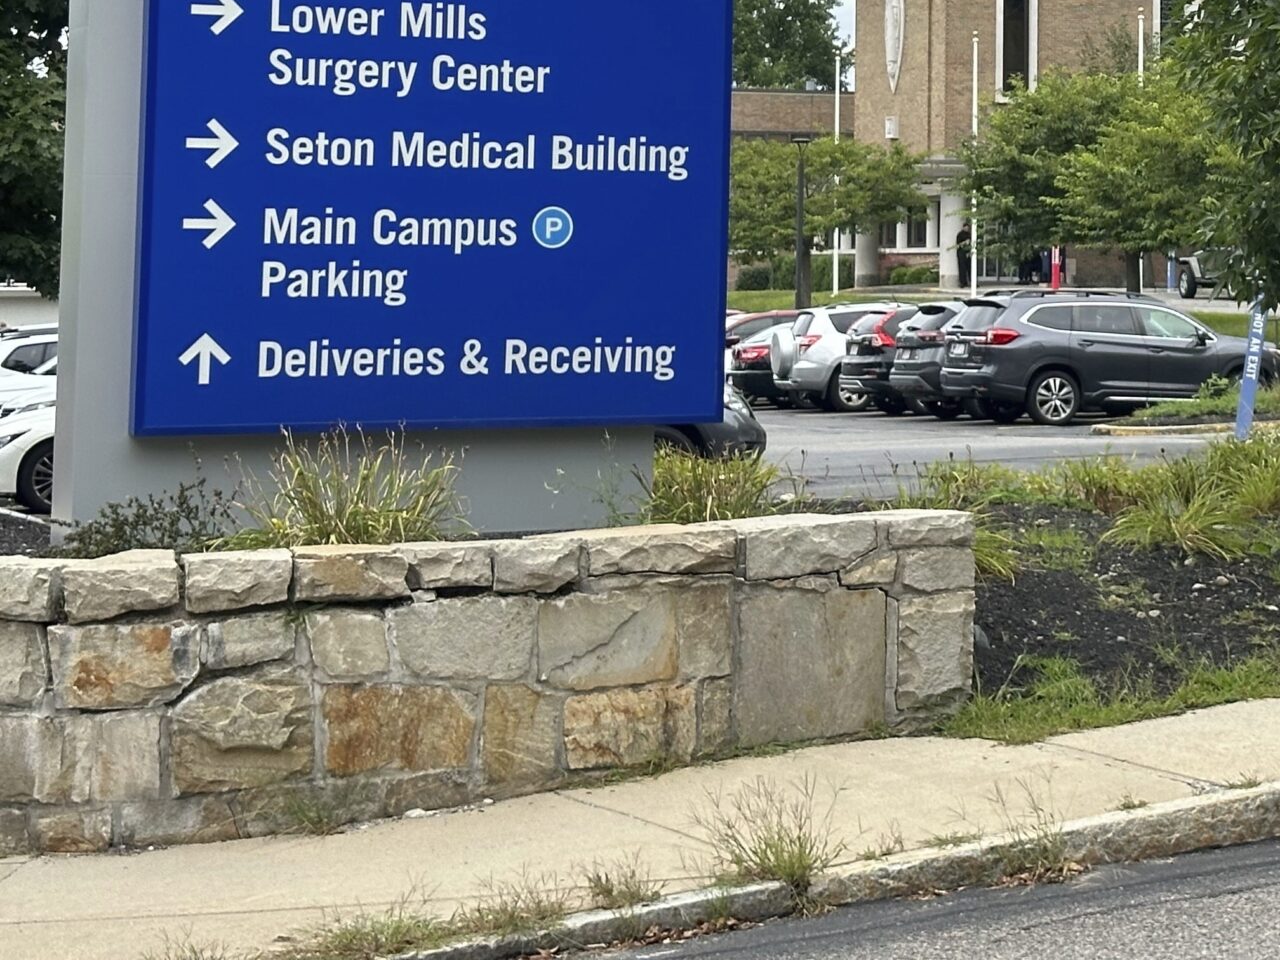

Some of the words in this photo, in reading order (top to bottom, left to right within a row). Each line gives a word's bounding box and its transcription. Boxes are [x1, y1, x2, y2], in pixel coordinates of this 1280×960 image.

[400, 1, 487, 41] Mills
[268, 48, 418, 98] Surgery
[431, 54, 551, 93] Center
[265, 127, 375, 167] Seton
[391, 131, 536, 170] Medical
[551, 134, 690, 181] Building
[263, 207, 357, 246] Main
[373, 208, 518, 255] Campus
[546, 217, 563, 239] P
[261, 259, 408, 306] Parking
[1250, 337, 1261, 352] AN
[1252, 312, 1264, 334] NOT
[258, 338, 445, 379] Deliveries
[459, 338, 489, 376] &
[504, 336, 677, 381] Receiving
[1246, 355, 1258, 380] EXIT
